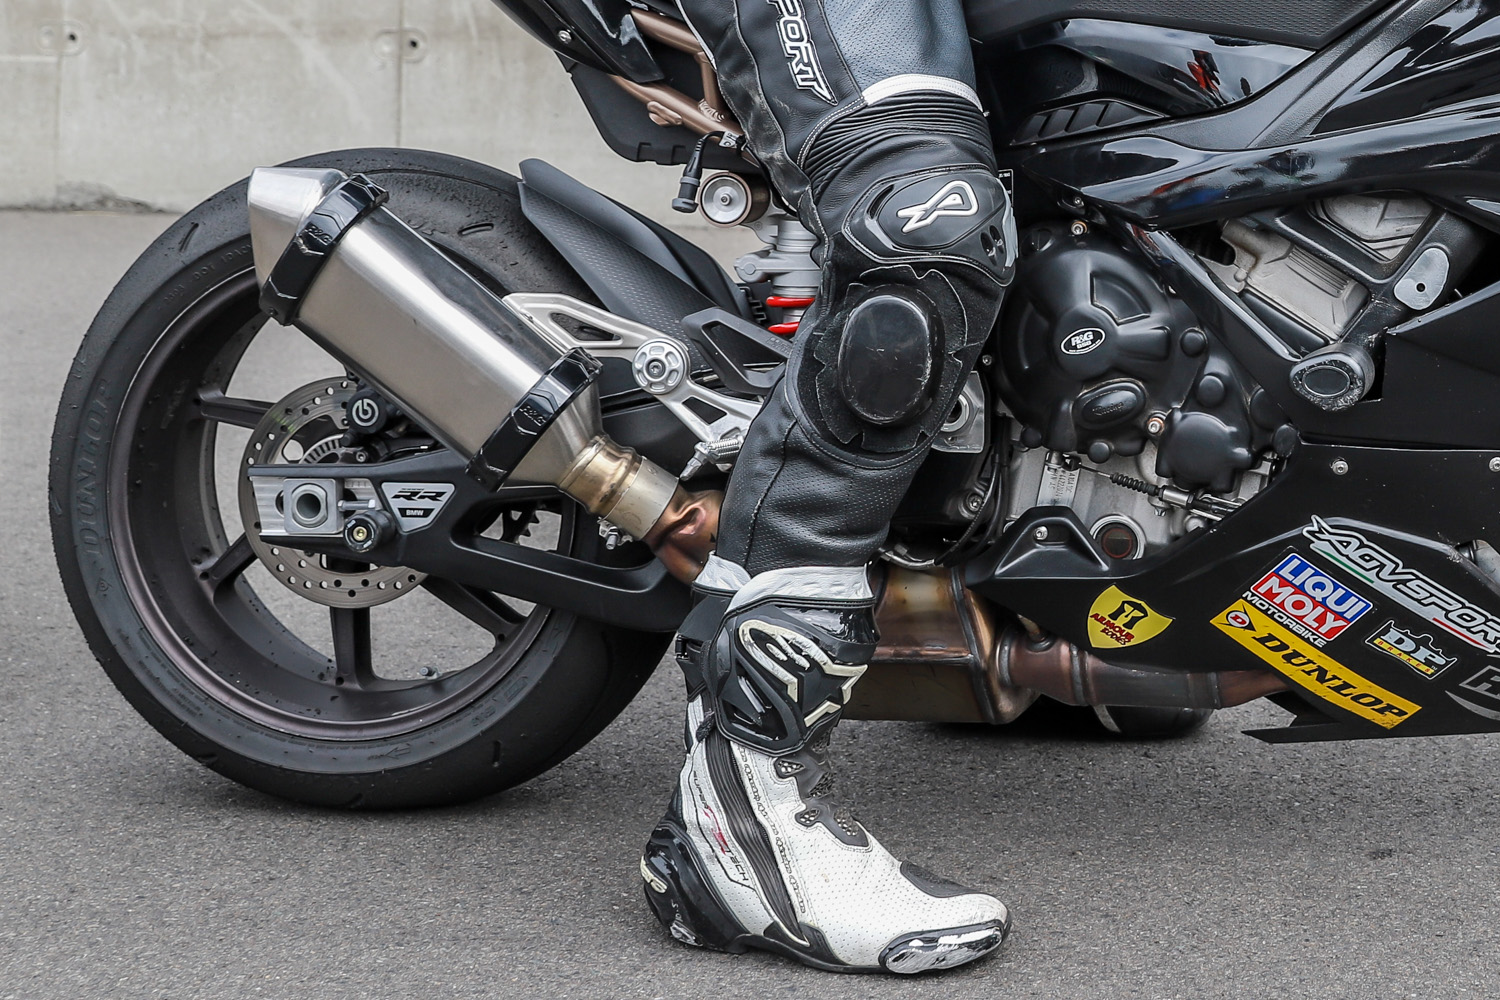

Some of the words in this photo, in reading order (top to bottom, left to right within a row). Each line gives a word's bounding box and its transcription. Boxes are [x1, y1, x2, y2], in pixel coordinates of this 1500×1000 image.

[1070, 331, 1095, 347] R&G
[405, 508, 425, 517] BMW
[1257, 574, 1349, 636] MOLY
[1278, 557, 1368, 621] LIQUI
[1241, 589, 1328, 649] MOTORBIKE
[1377, 640, 1432, 673] BRAKES
[1380, 627, 1447, 665] DP
[1250, 631, 1410, 719] DUNLOP
